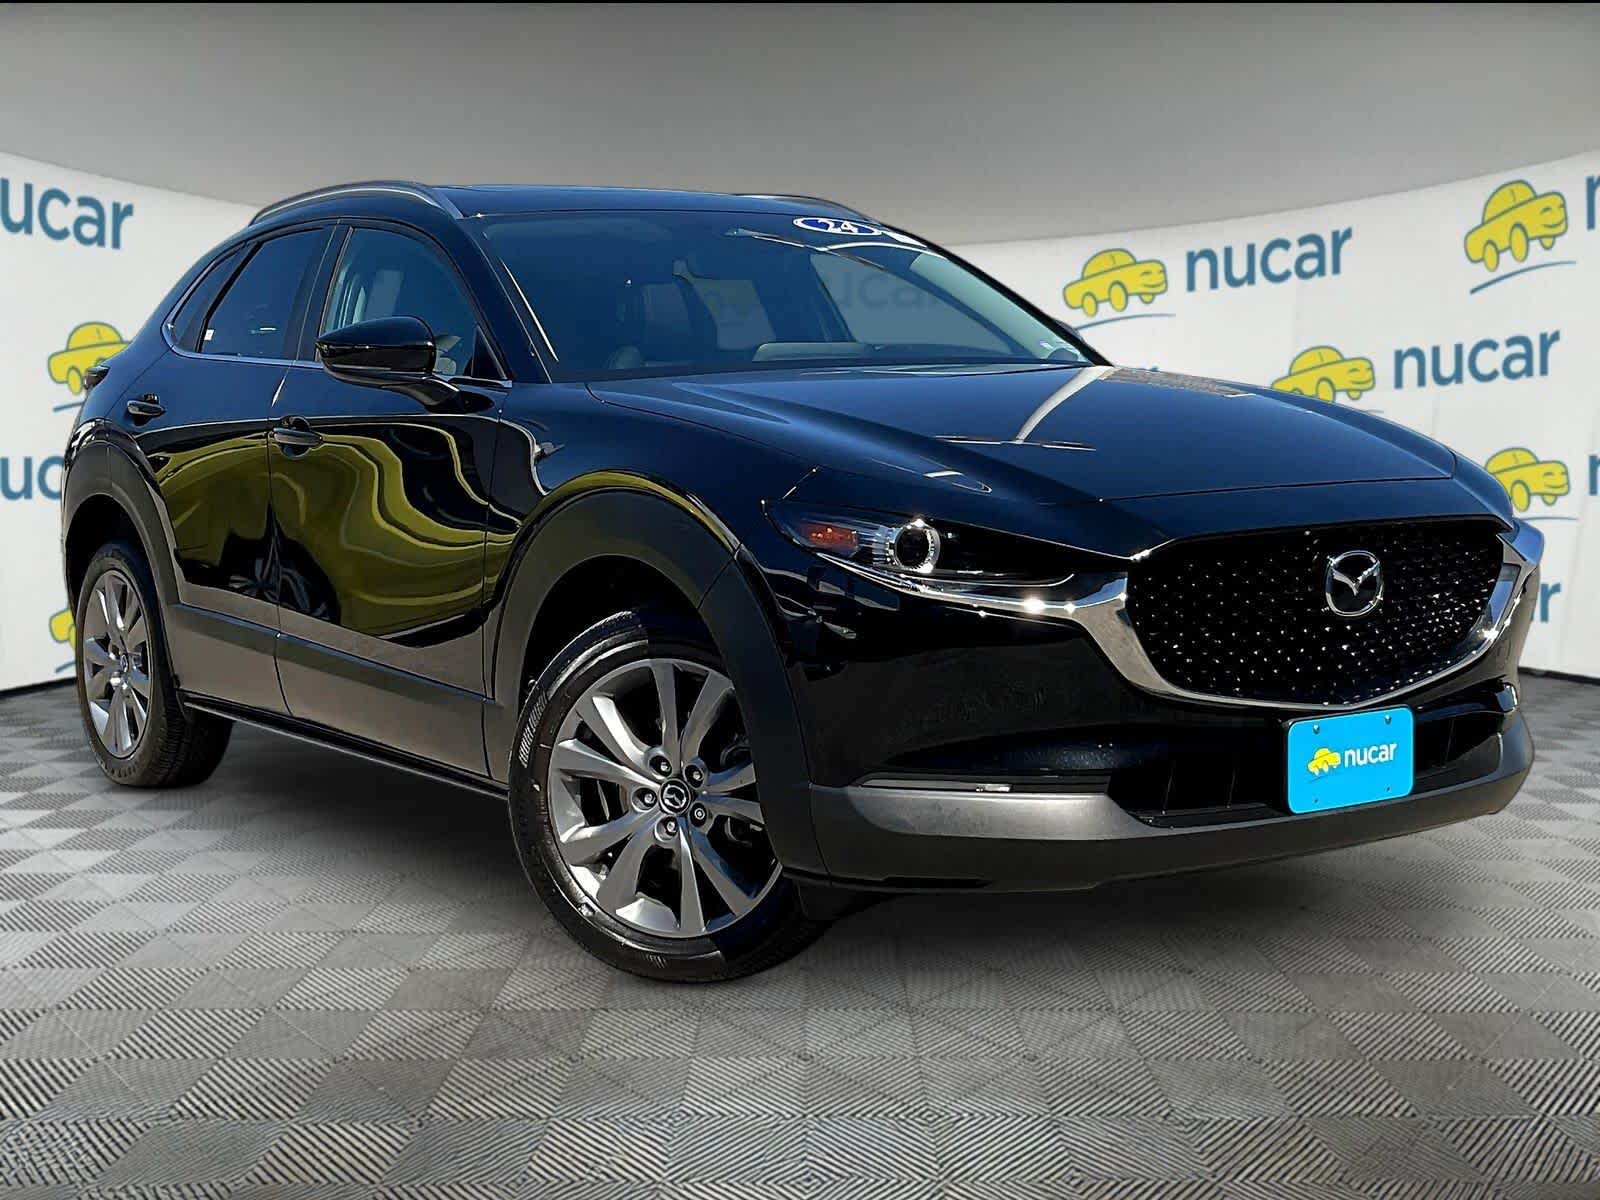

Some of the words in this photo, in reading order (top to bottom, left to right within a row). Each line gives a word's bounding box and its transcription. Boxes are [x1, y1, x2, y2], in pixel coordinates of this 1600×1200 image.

[0, 177, 134, 250] ucar
[1185, 226, 1353, 292] nucar
[1394, 329, 1561, 389] nucar
[1344, 743, 1397, 768] nucar
